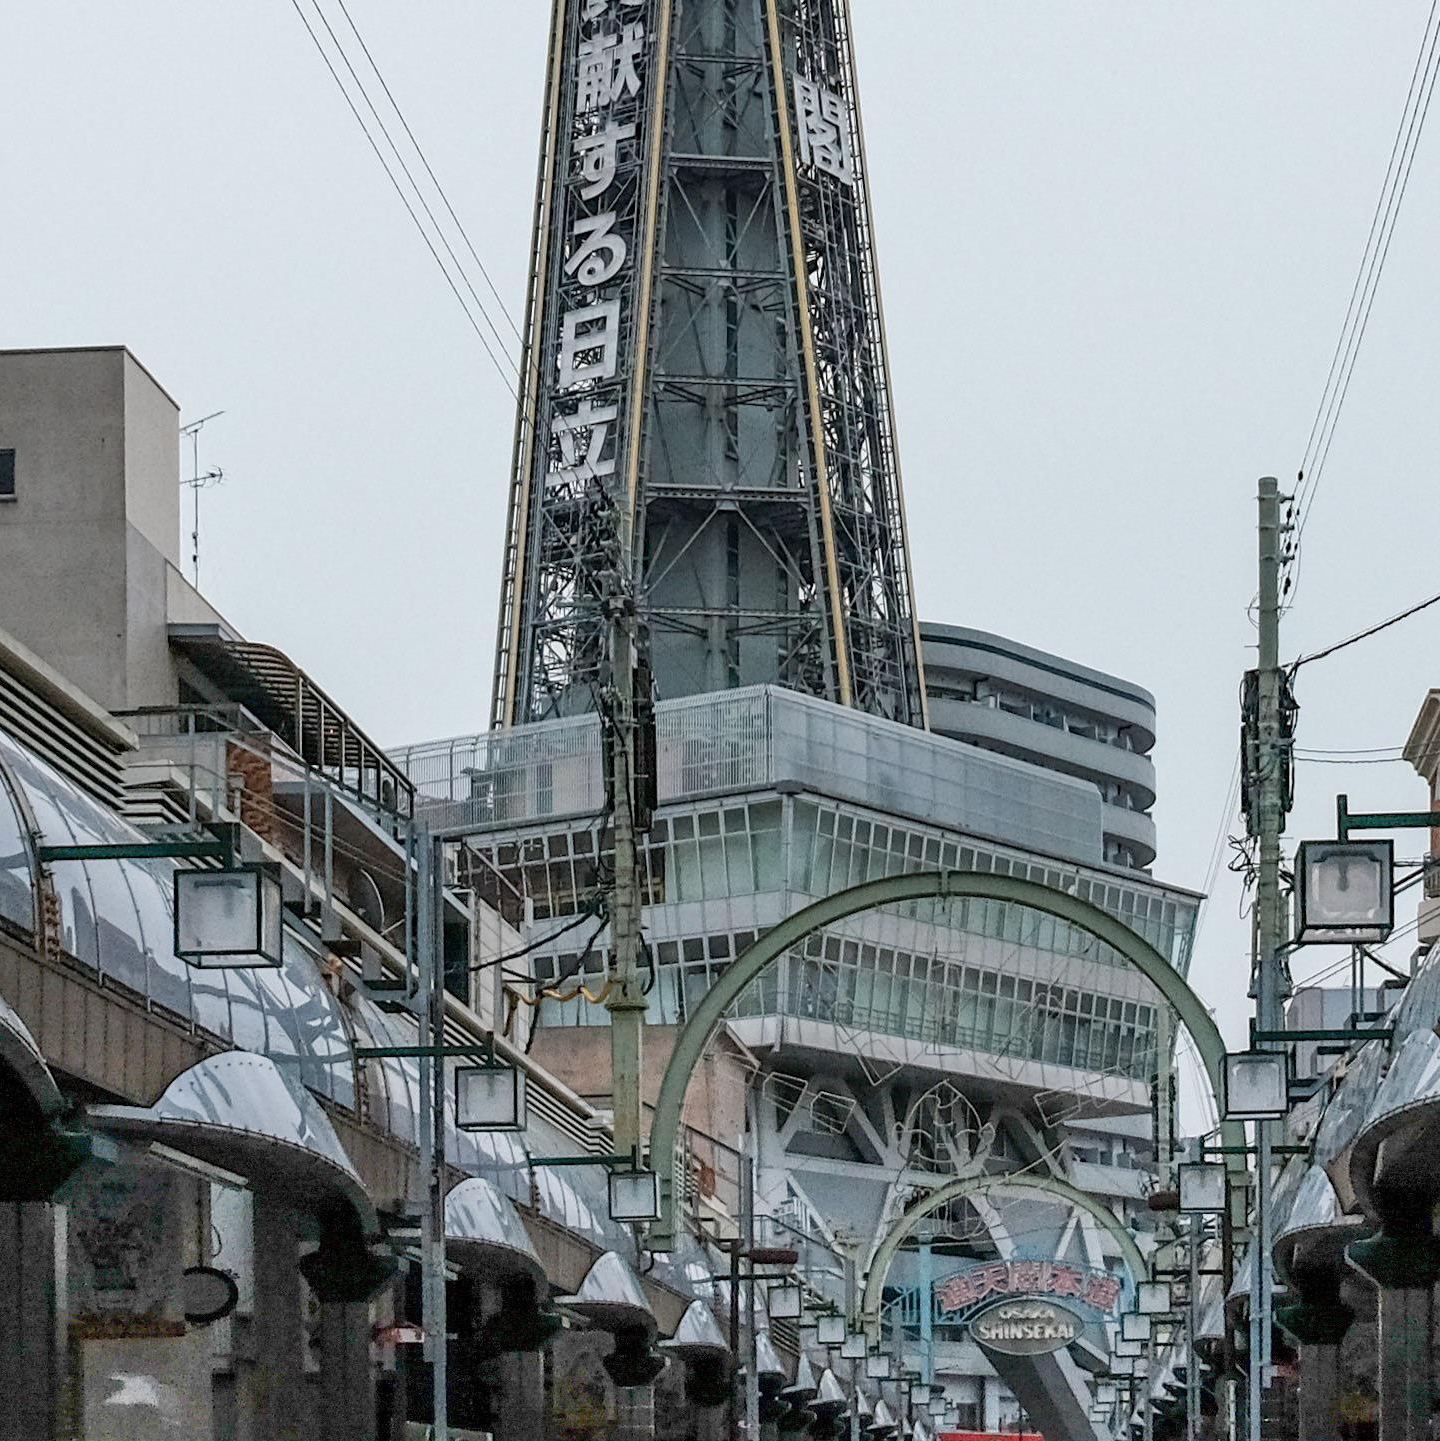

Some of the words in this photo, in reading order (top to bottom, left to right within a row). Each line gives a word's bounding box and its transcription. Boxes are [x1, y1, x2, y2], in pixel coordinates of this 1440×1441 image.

[935, 1260, 1121, 1312] 通天閣本通
[999, 1308, 1056, 1320] OSAKA
[979, 1323, 1075, 1340] SHINSEKAI
